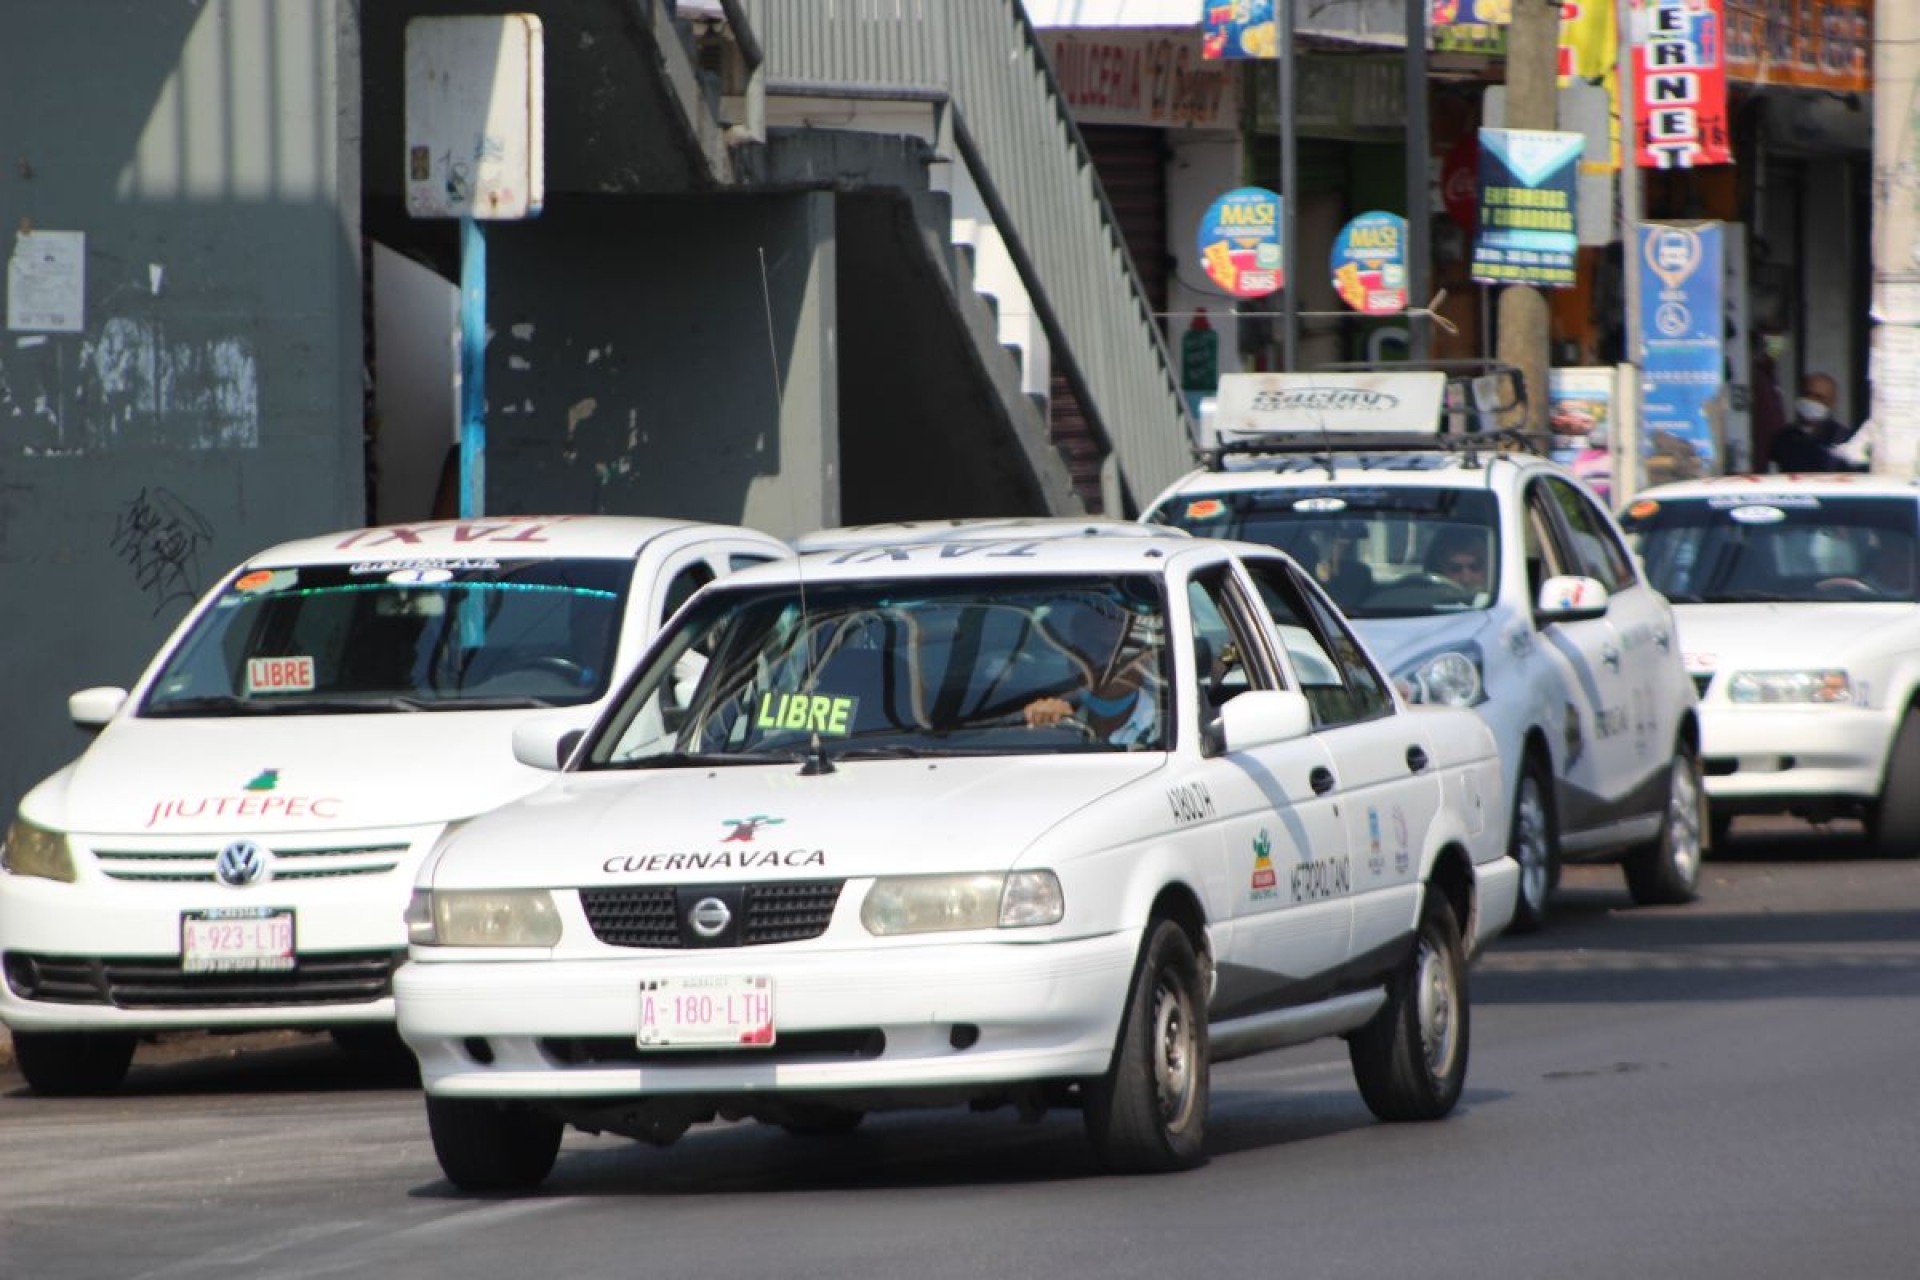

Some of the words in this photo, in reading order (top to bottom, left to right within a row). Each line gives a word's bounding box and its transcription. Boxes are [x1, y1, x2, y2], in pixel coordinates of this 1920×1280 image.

[336, 522, 549, 550] TAXI
[828, 540, 1044, 565] TAXI
[252, 660, 311, 688] LIBRE
[757, 692, 852, 735] LIBRE
[146, 796, 344, 829] JIUTEPEC
[602, 849, 827, 874] CUERNAVACA
[643, 994, 770, 1026] A-180-LTH
